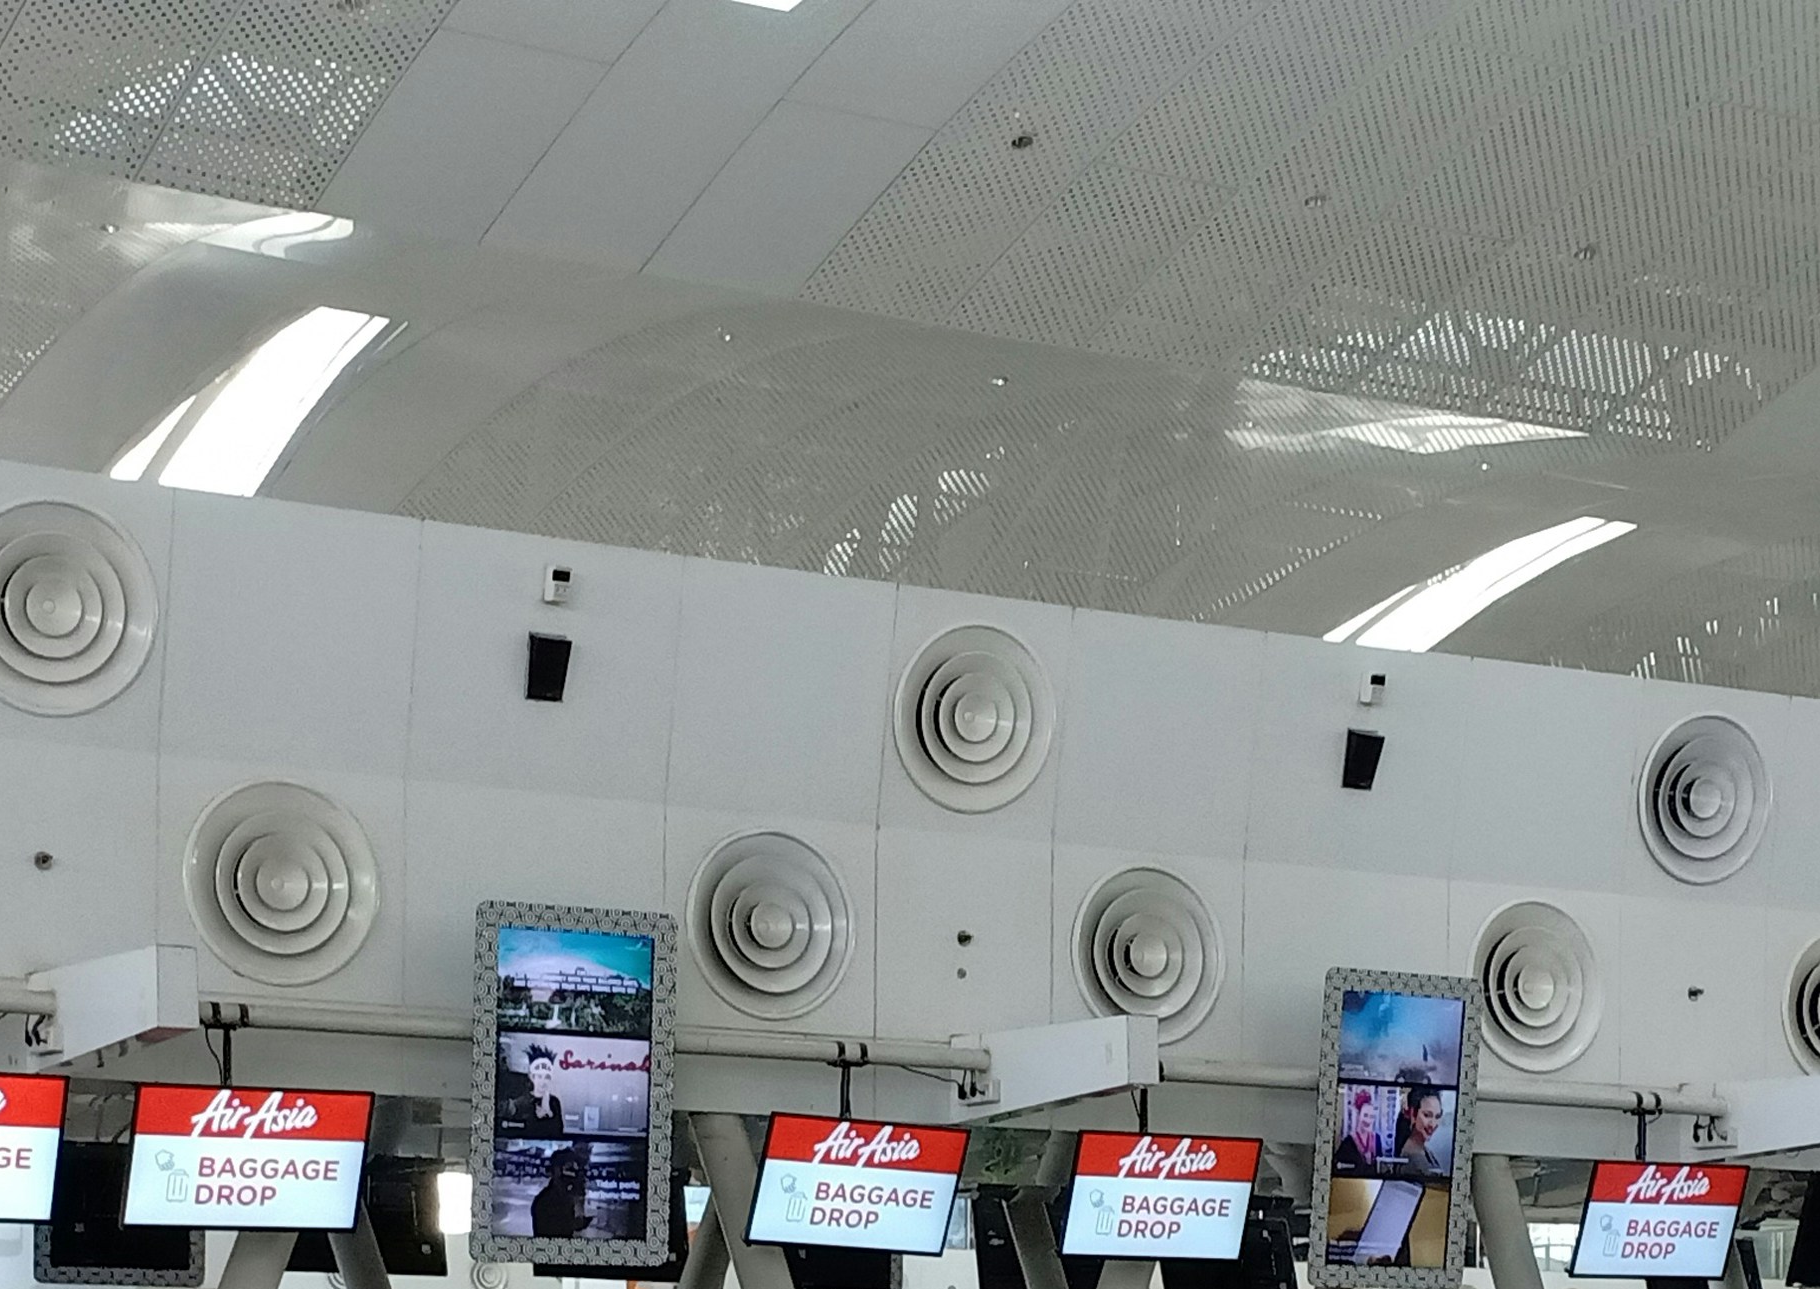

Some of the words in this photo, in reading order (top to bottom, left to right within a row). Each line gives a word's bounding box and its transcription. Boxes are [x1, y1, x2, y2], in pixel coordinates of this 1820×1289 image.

[198, 1156, 340, 1181] BAGGAGE
[194, 1184, 277, 1206] DROP
[814, 1181, 935, 1209] BAGGAGE
[1121, 1195, 1232, 1217] BAGGAGE
[809, 1207, 879, 1229] DROP
[1117, 1219, 1181, 1239] DROP
[1626, 1219, 1720, 1239] BAGGAGE
[1621, 1241, 1676, 1260] DROP
